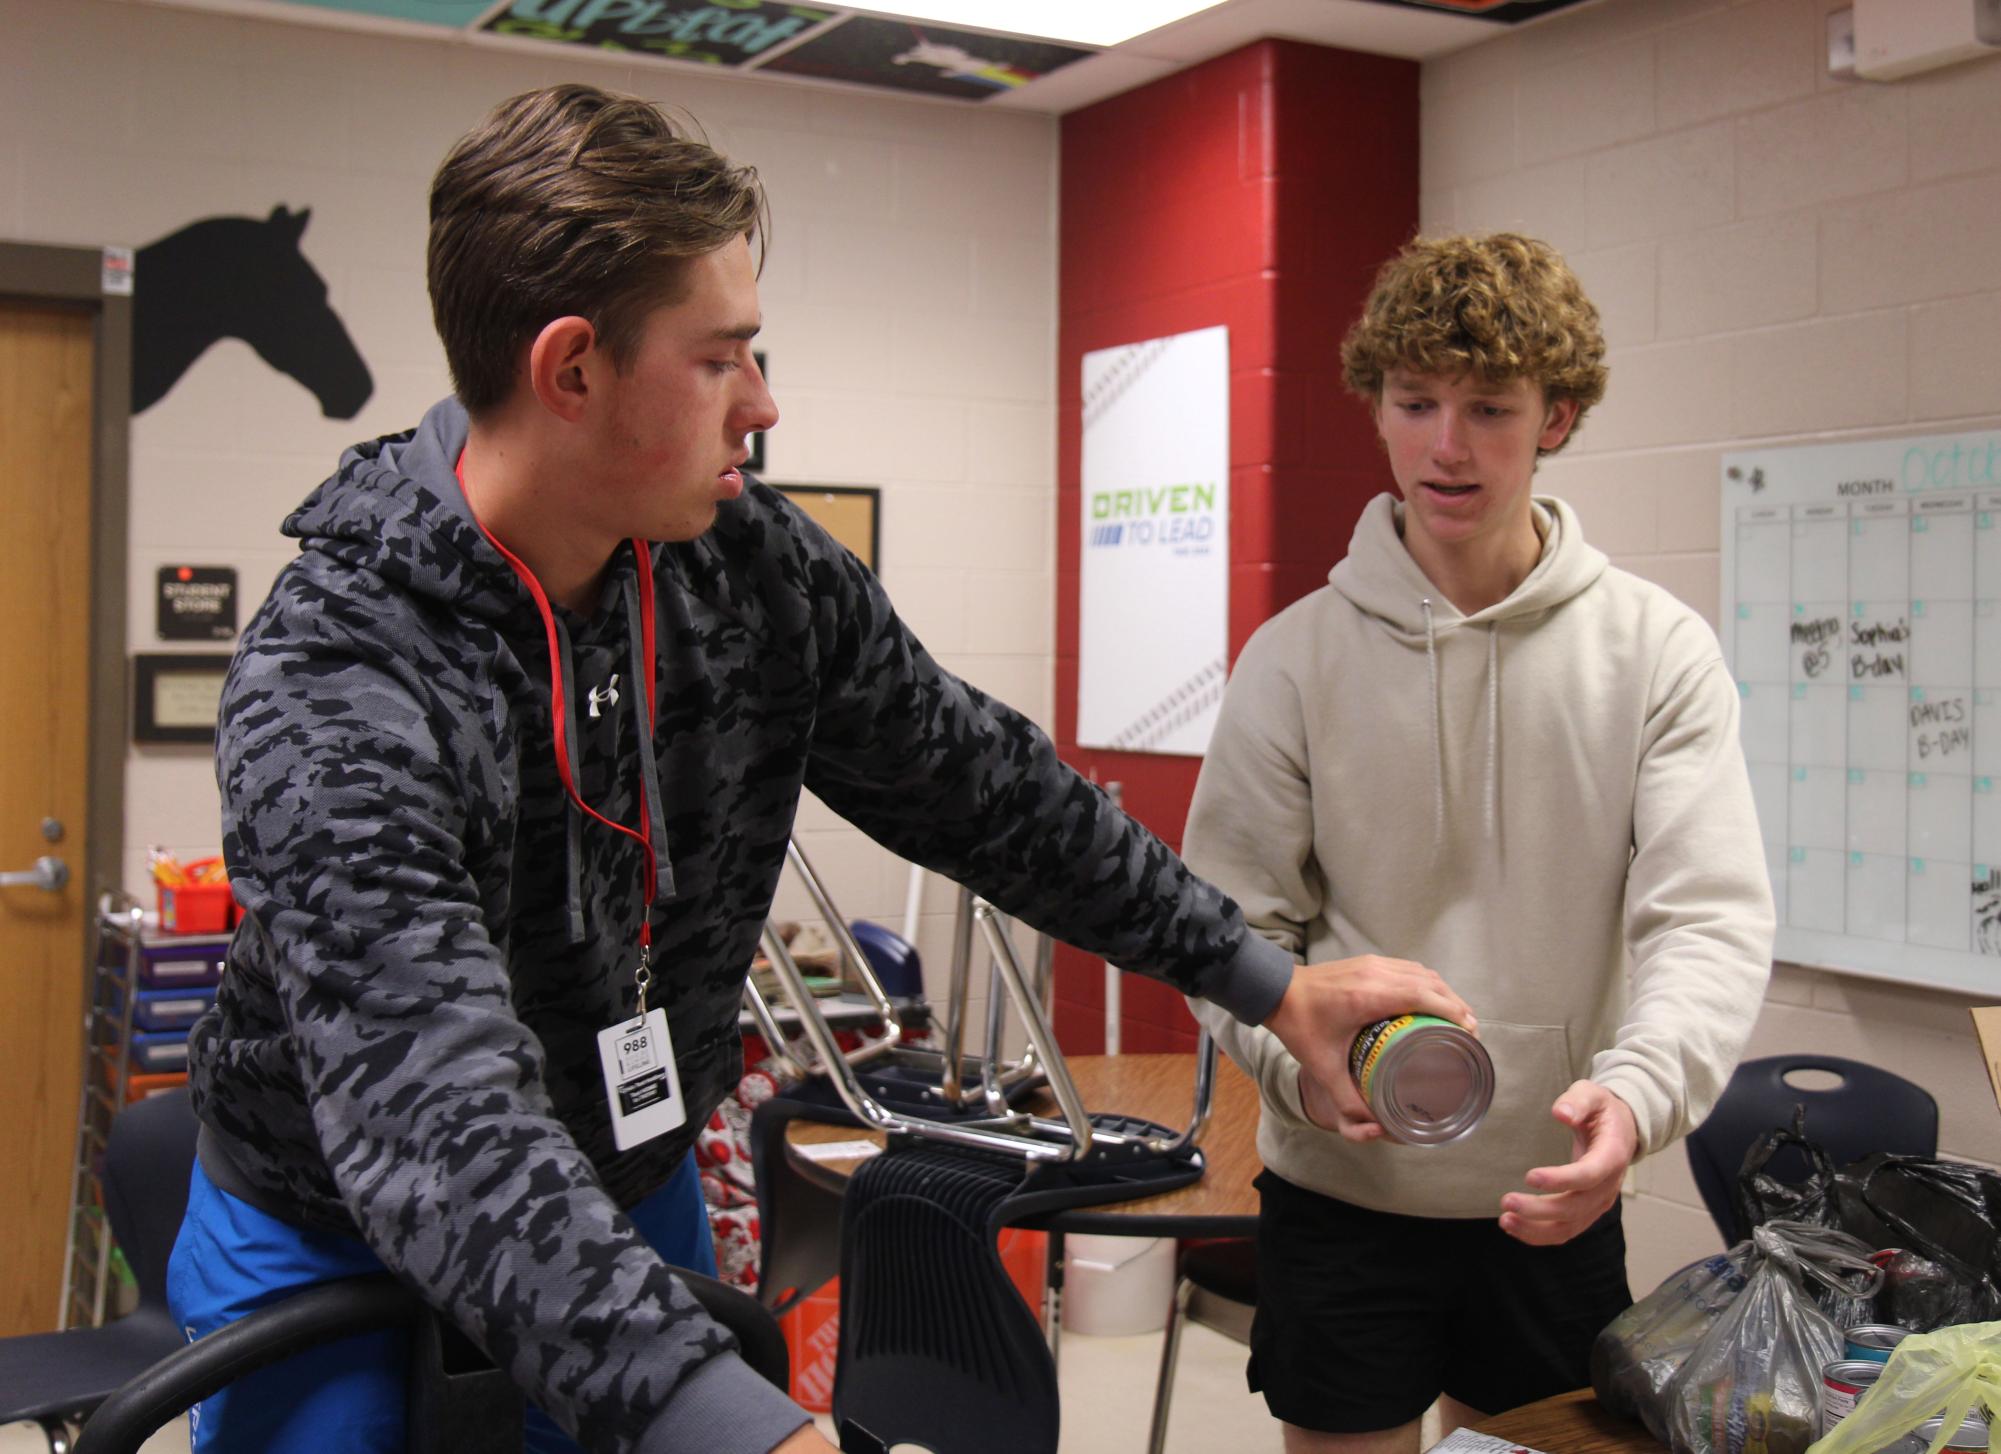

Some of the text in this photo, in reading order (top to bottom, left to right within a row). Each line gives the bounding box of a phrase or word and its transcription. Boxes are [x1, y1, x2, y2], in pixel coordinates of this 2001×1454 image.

[1837, 479, 1894, 497] MONTH
[1092, 482, 1215, 519] DRIVEN
[1159, 515, 1213, 544] LEAD
[623, 1036, 648, 1054] 988
